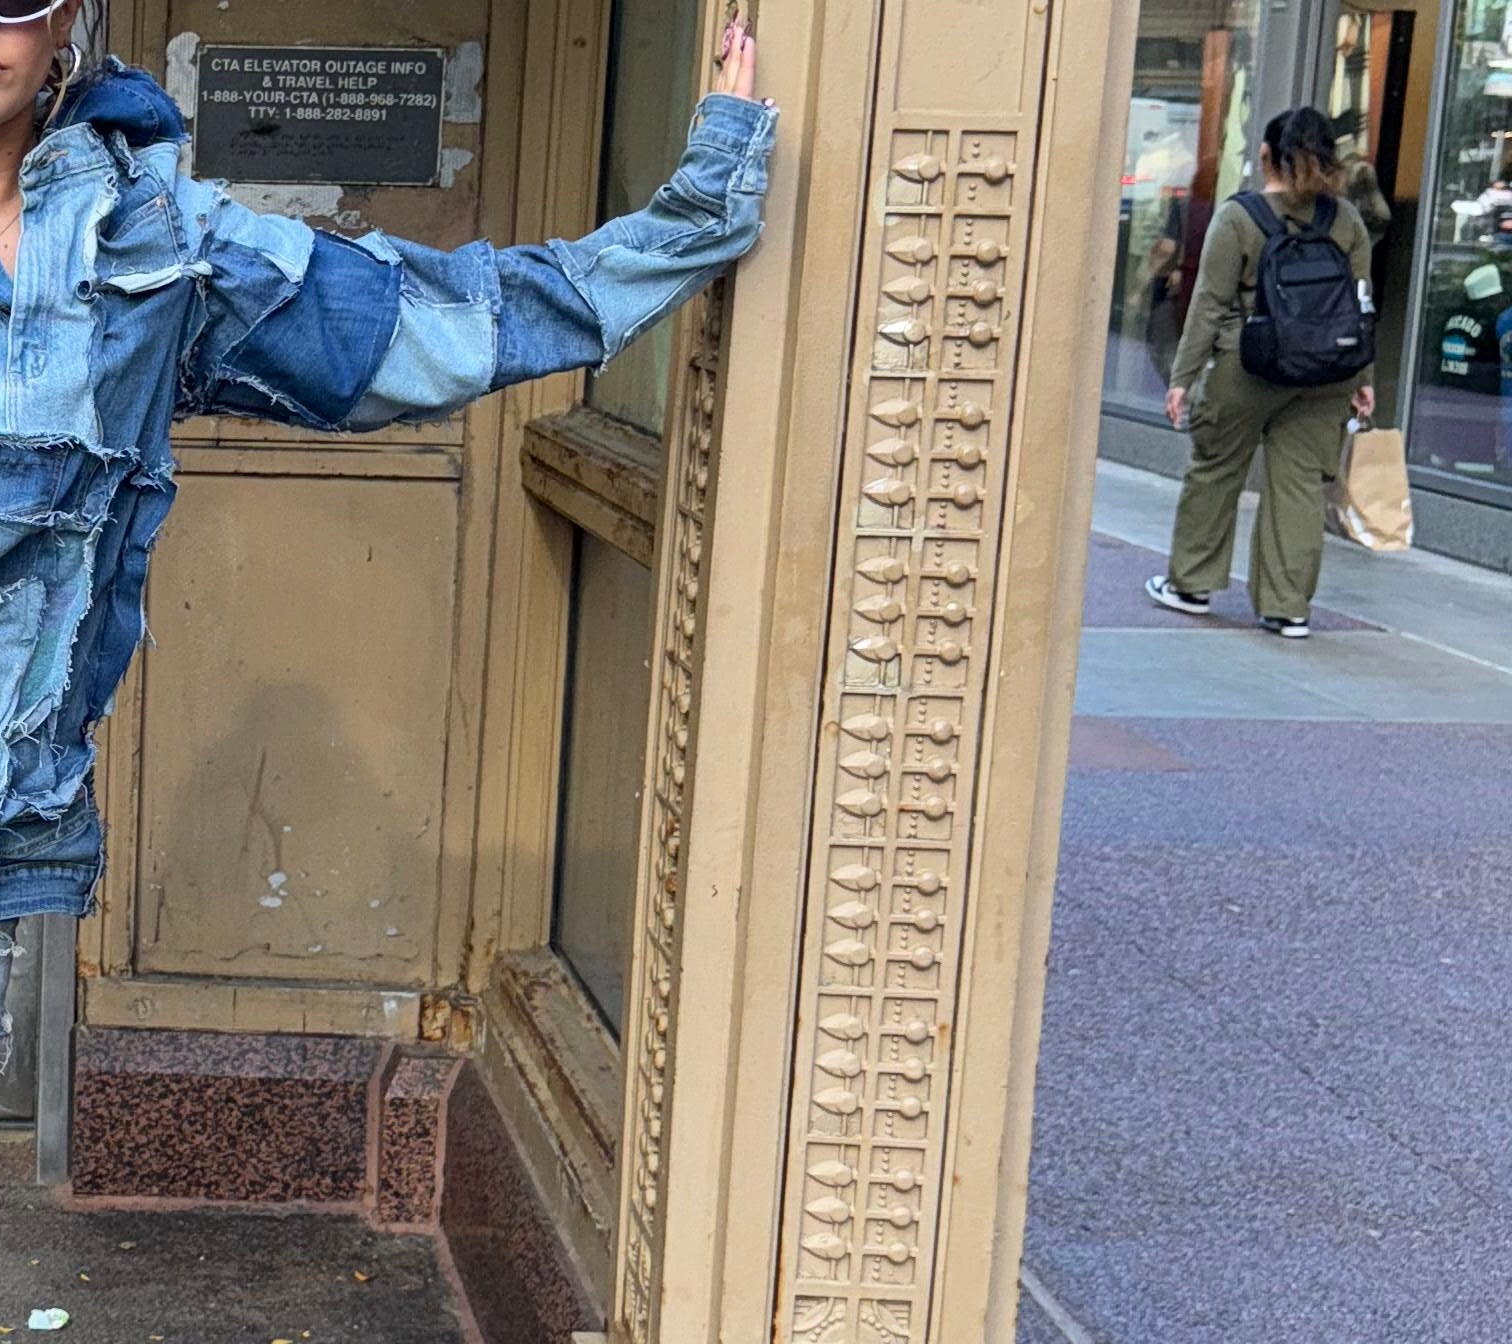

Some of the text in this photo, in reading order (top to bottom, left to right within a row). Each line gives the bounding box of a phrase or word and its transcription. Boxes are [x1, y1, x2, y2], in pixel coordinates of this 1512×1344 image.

[211, 58, 426, 75] CTA ELEVATOR OUTAGE INFO
[262, 76, 378, 90] & TRAVEL HELP
[201, 90, 437, 108] 1-888-YOUR-CTA (1-888-968-7282)
[248, 106, 388, 121] TTY: 1-888-282-8891
